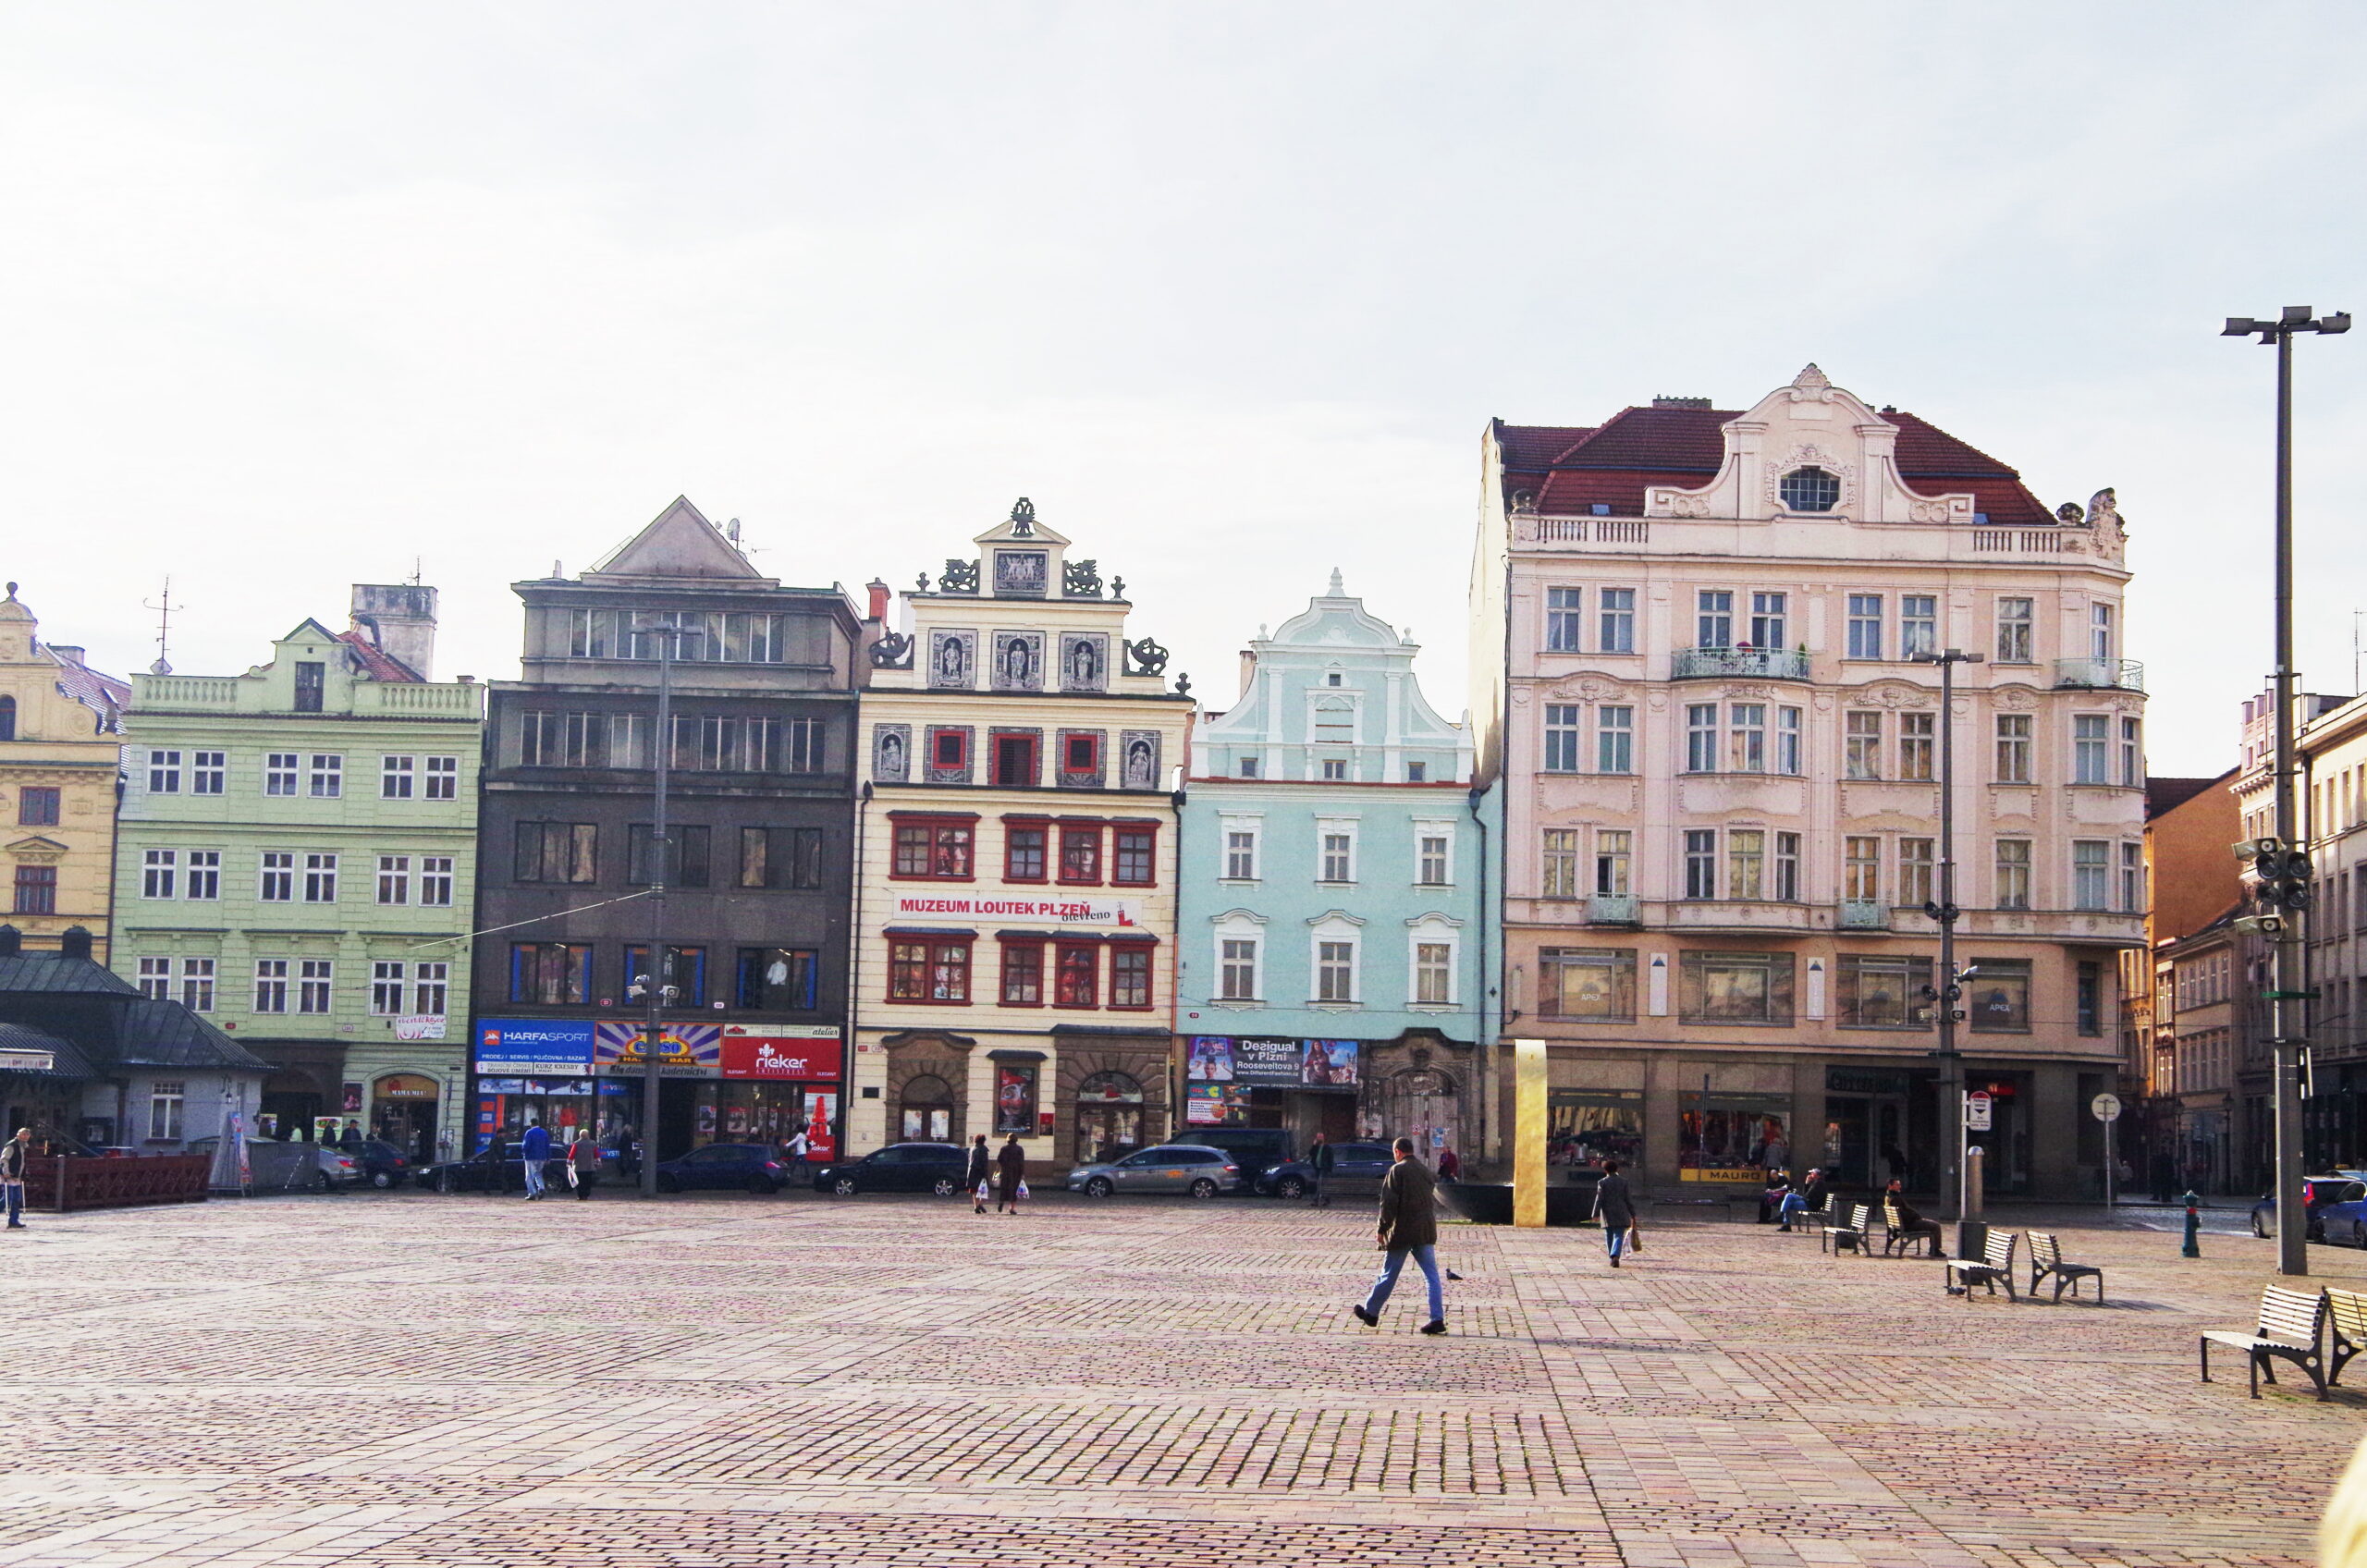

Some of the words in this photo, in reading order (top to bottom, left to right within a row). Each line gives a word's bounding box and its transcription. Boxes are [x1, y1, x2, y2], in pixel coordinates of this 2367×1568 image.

[901, 900, 970, 913] MUZEUM
[975, 901, 1035, 915] LOUTEK
[1038, 900, 1091, 916] PLZEŇ
[1061, 910, 1110, 922] otevřeno
[1989, 1004, 2010, 1012] APEX
[812, 1027, 838, 1035] atelier
[504, 1032, 589, 1042] HARFASPORT
[1242, 1040, 1295, 1053] Desigual
[755, 1053, 808, 1068] rieker
[1258, 1051, 1287, 1060] Plzni
[1236, 1061, 1293, 1071] Rooseveltova
[1294, 1062, 1300, 1071] 9
[1711, 1171, 1760, 1180] MAURO
